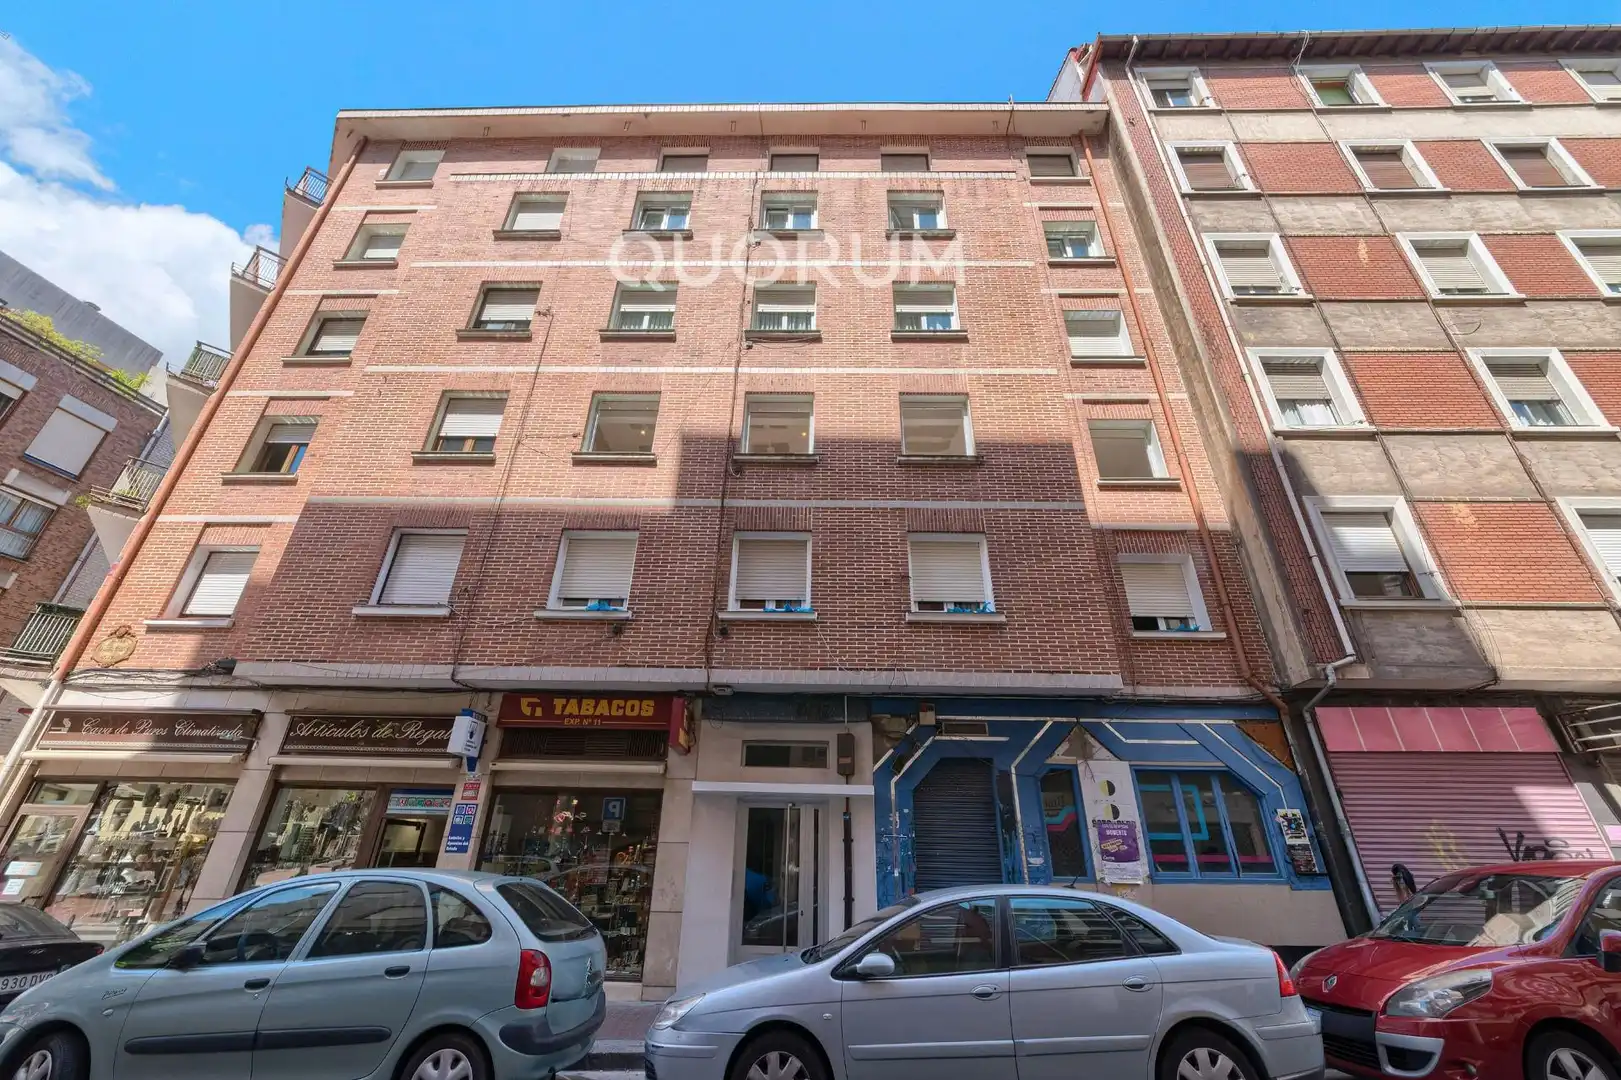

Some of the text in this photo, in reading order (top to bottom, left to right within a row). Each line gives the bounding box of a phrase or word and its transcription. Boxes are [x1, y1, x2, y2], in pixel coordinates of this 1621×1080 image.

[553, 698, 655, 716] TABACOS
[81, 717, 244, 737] Cava de Puros Climatizada
[372, 721, 394, 739] de
[395, 720, 453, 746] Regal
